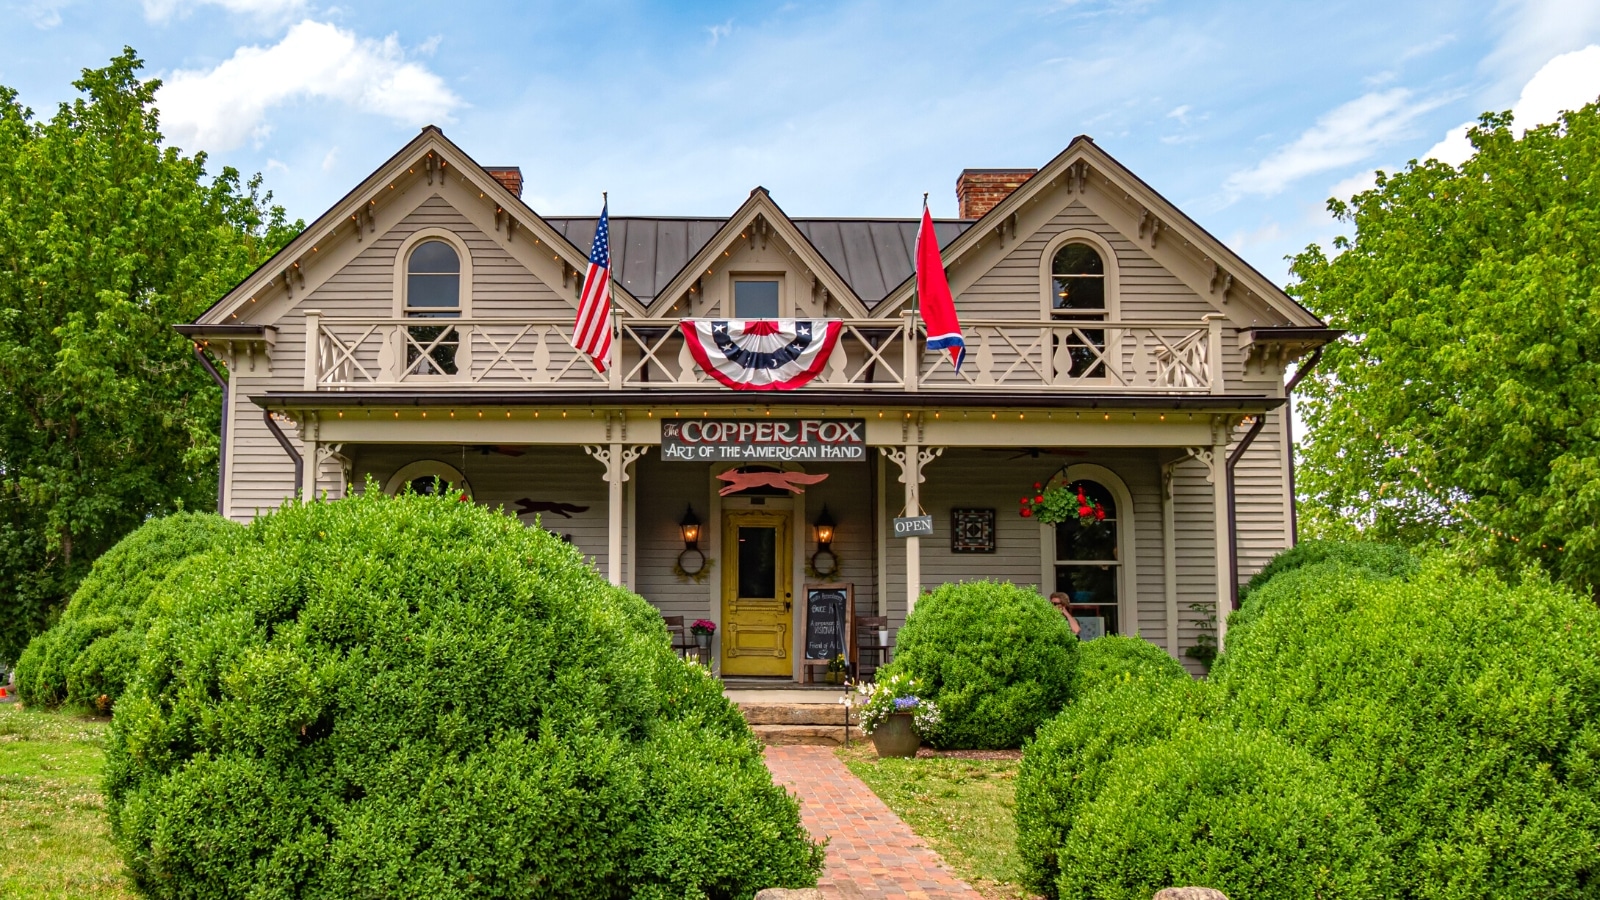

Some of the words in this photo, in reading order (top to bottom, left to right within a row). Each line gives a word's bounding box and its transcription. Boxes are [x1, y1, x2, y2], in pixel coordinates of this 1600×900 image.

[663, 422, 679, 437] The
[681, 420, 799, 443] COPPER
[800, 420, 863, 443] FOX
[665, 443, 695, 460] ART
[698, 445, 715, 458] OF
[719, 446, 741, 458] THE
[742, 444, 817, 460] AMERICAN
[820, 444, 862, 458] HAND
[895, 519, 931, 533] OPEN
